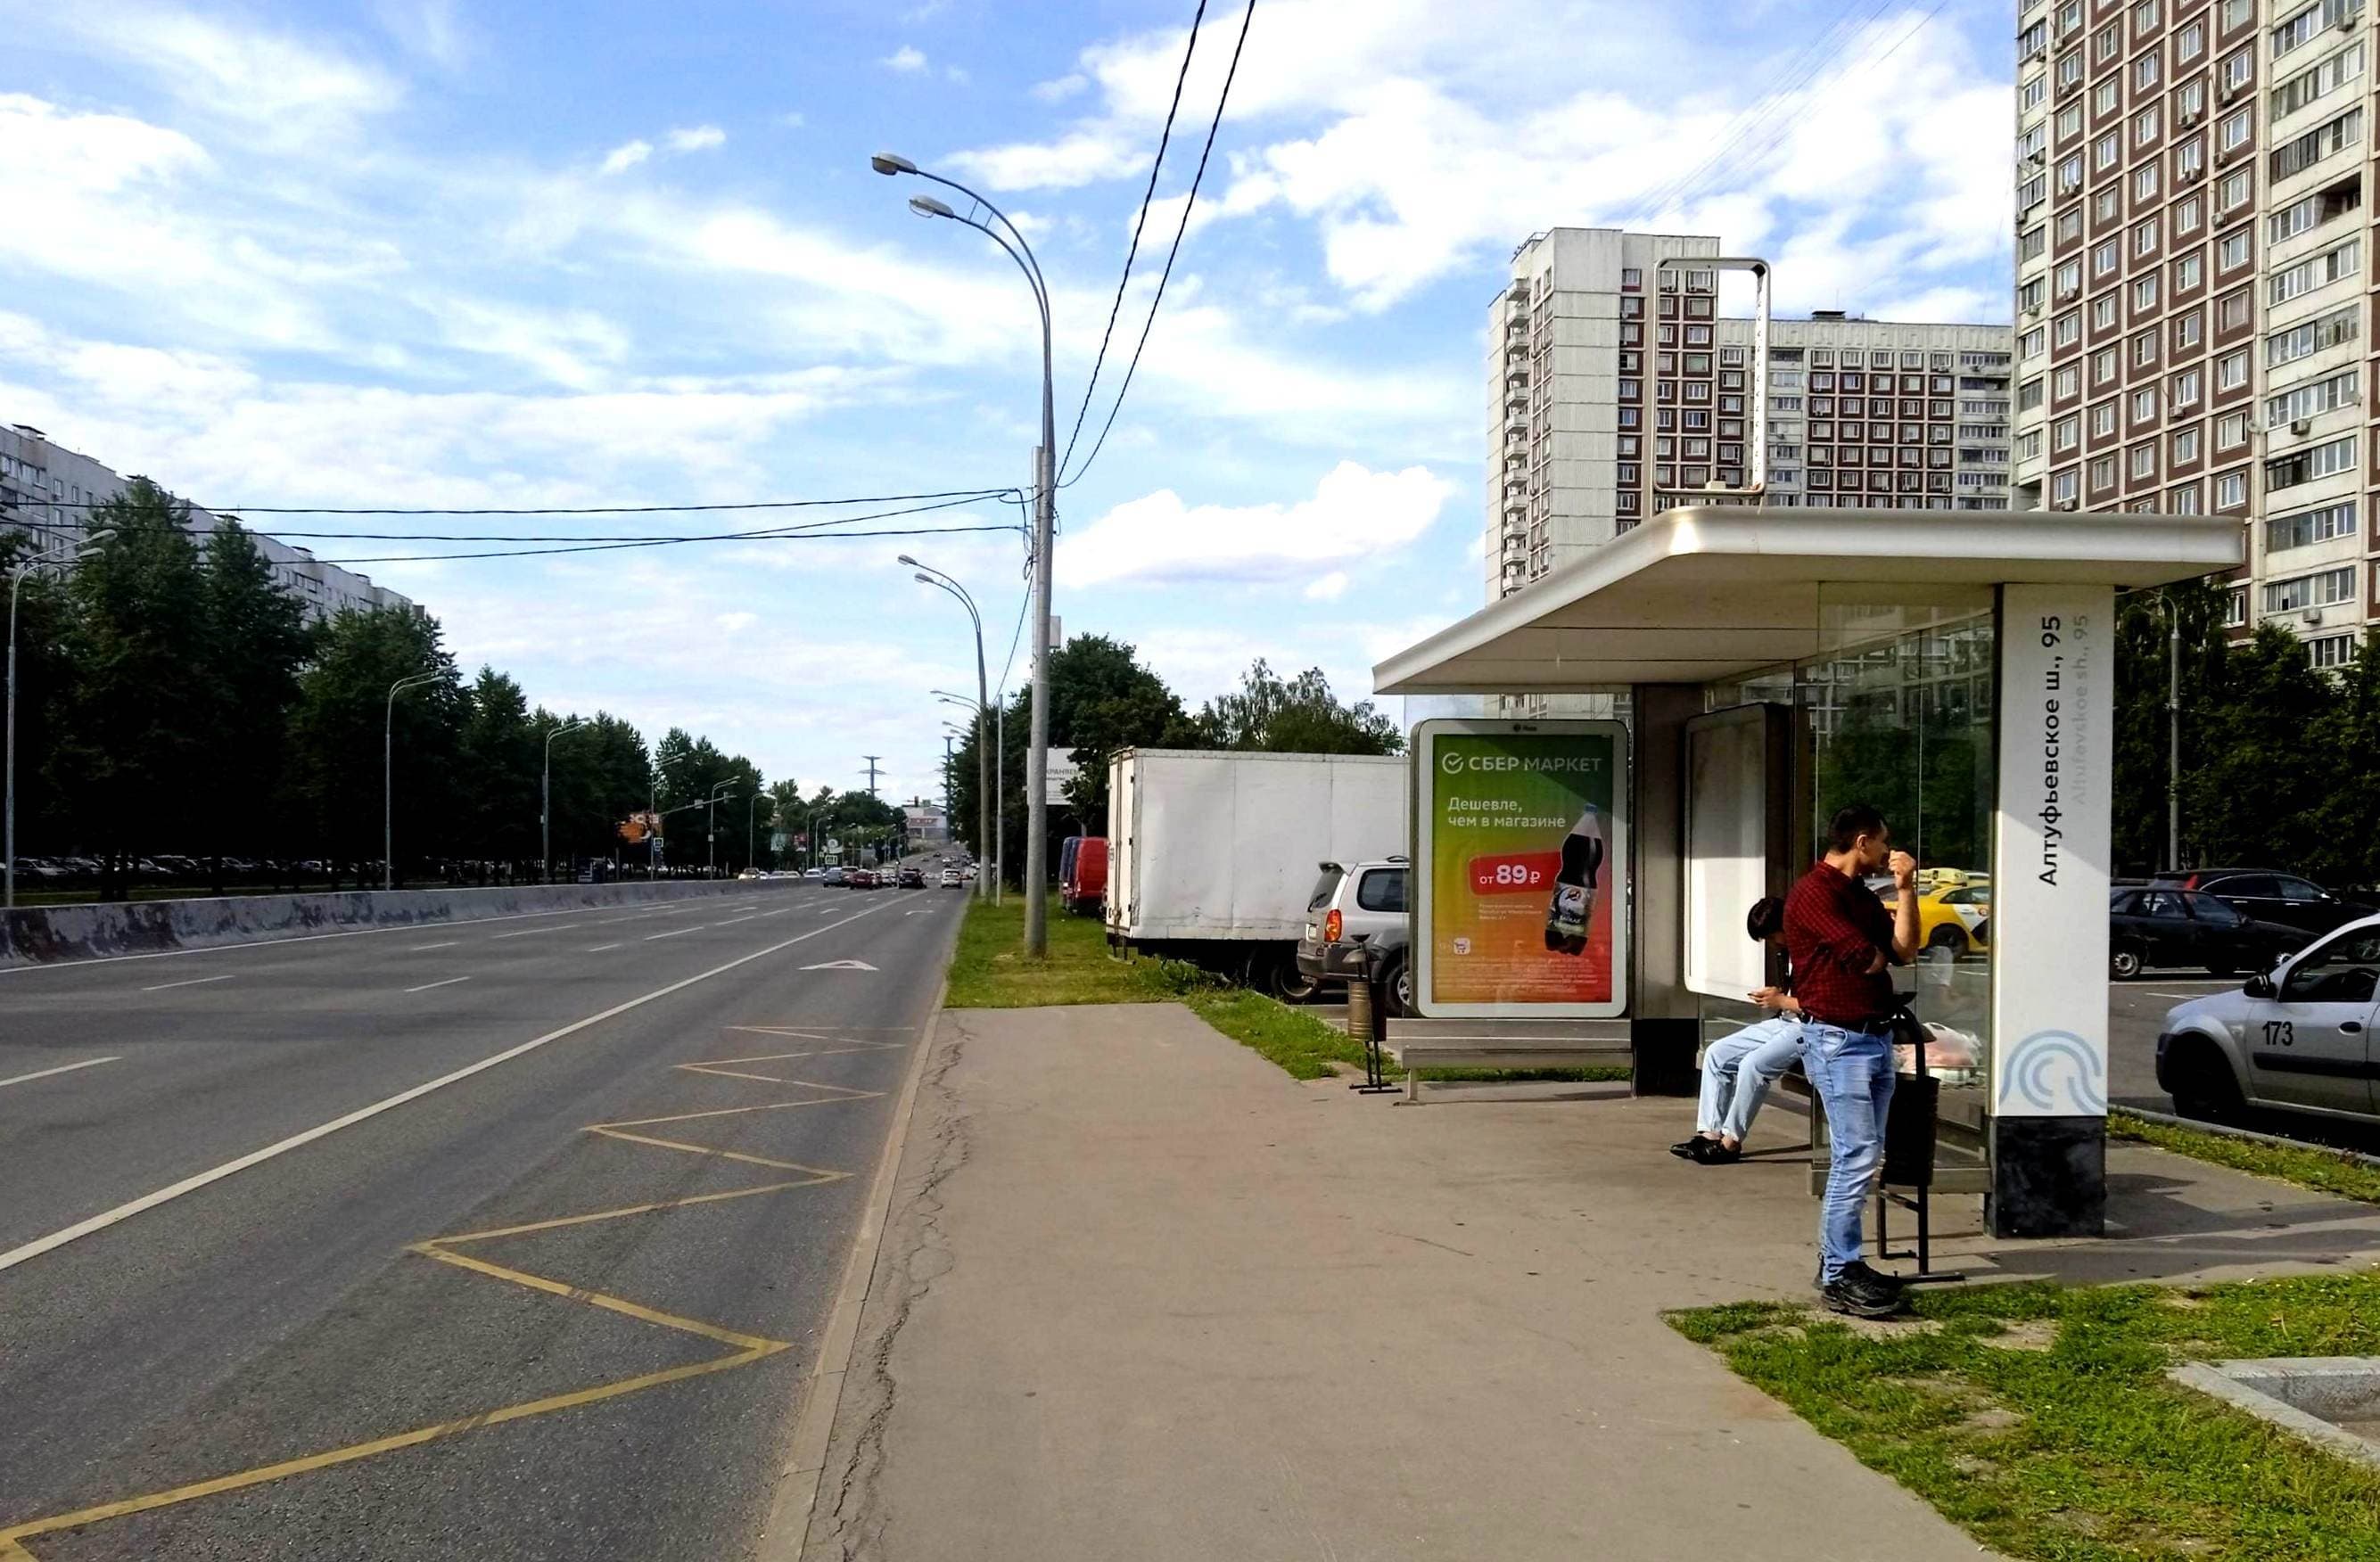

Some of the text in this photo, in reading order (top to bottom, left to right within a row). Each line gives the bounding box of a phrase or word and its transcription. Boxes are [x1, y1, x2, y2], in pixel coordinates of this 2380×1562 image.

[2073, 615, 2089, 641] 95
[2038, 615, 2064, 886] Алтуфьевское ш., 95
[1469, 757, 1602, 772] СБЕР МАРКЕТ
[1447, 797, 1523, 813] Дешевле,
[1448, 816, 1567, 828] чем в магазине
[1479, 876, 1495, 884] от
[1495, 864, 1528, 884] 89
[2261, 1020, 2294, 1047] 173
